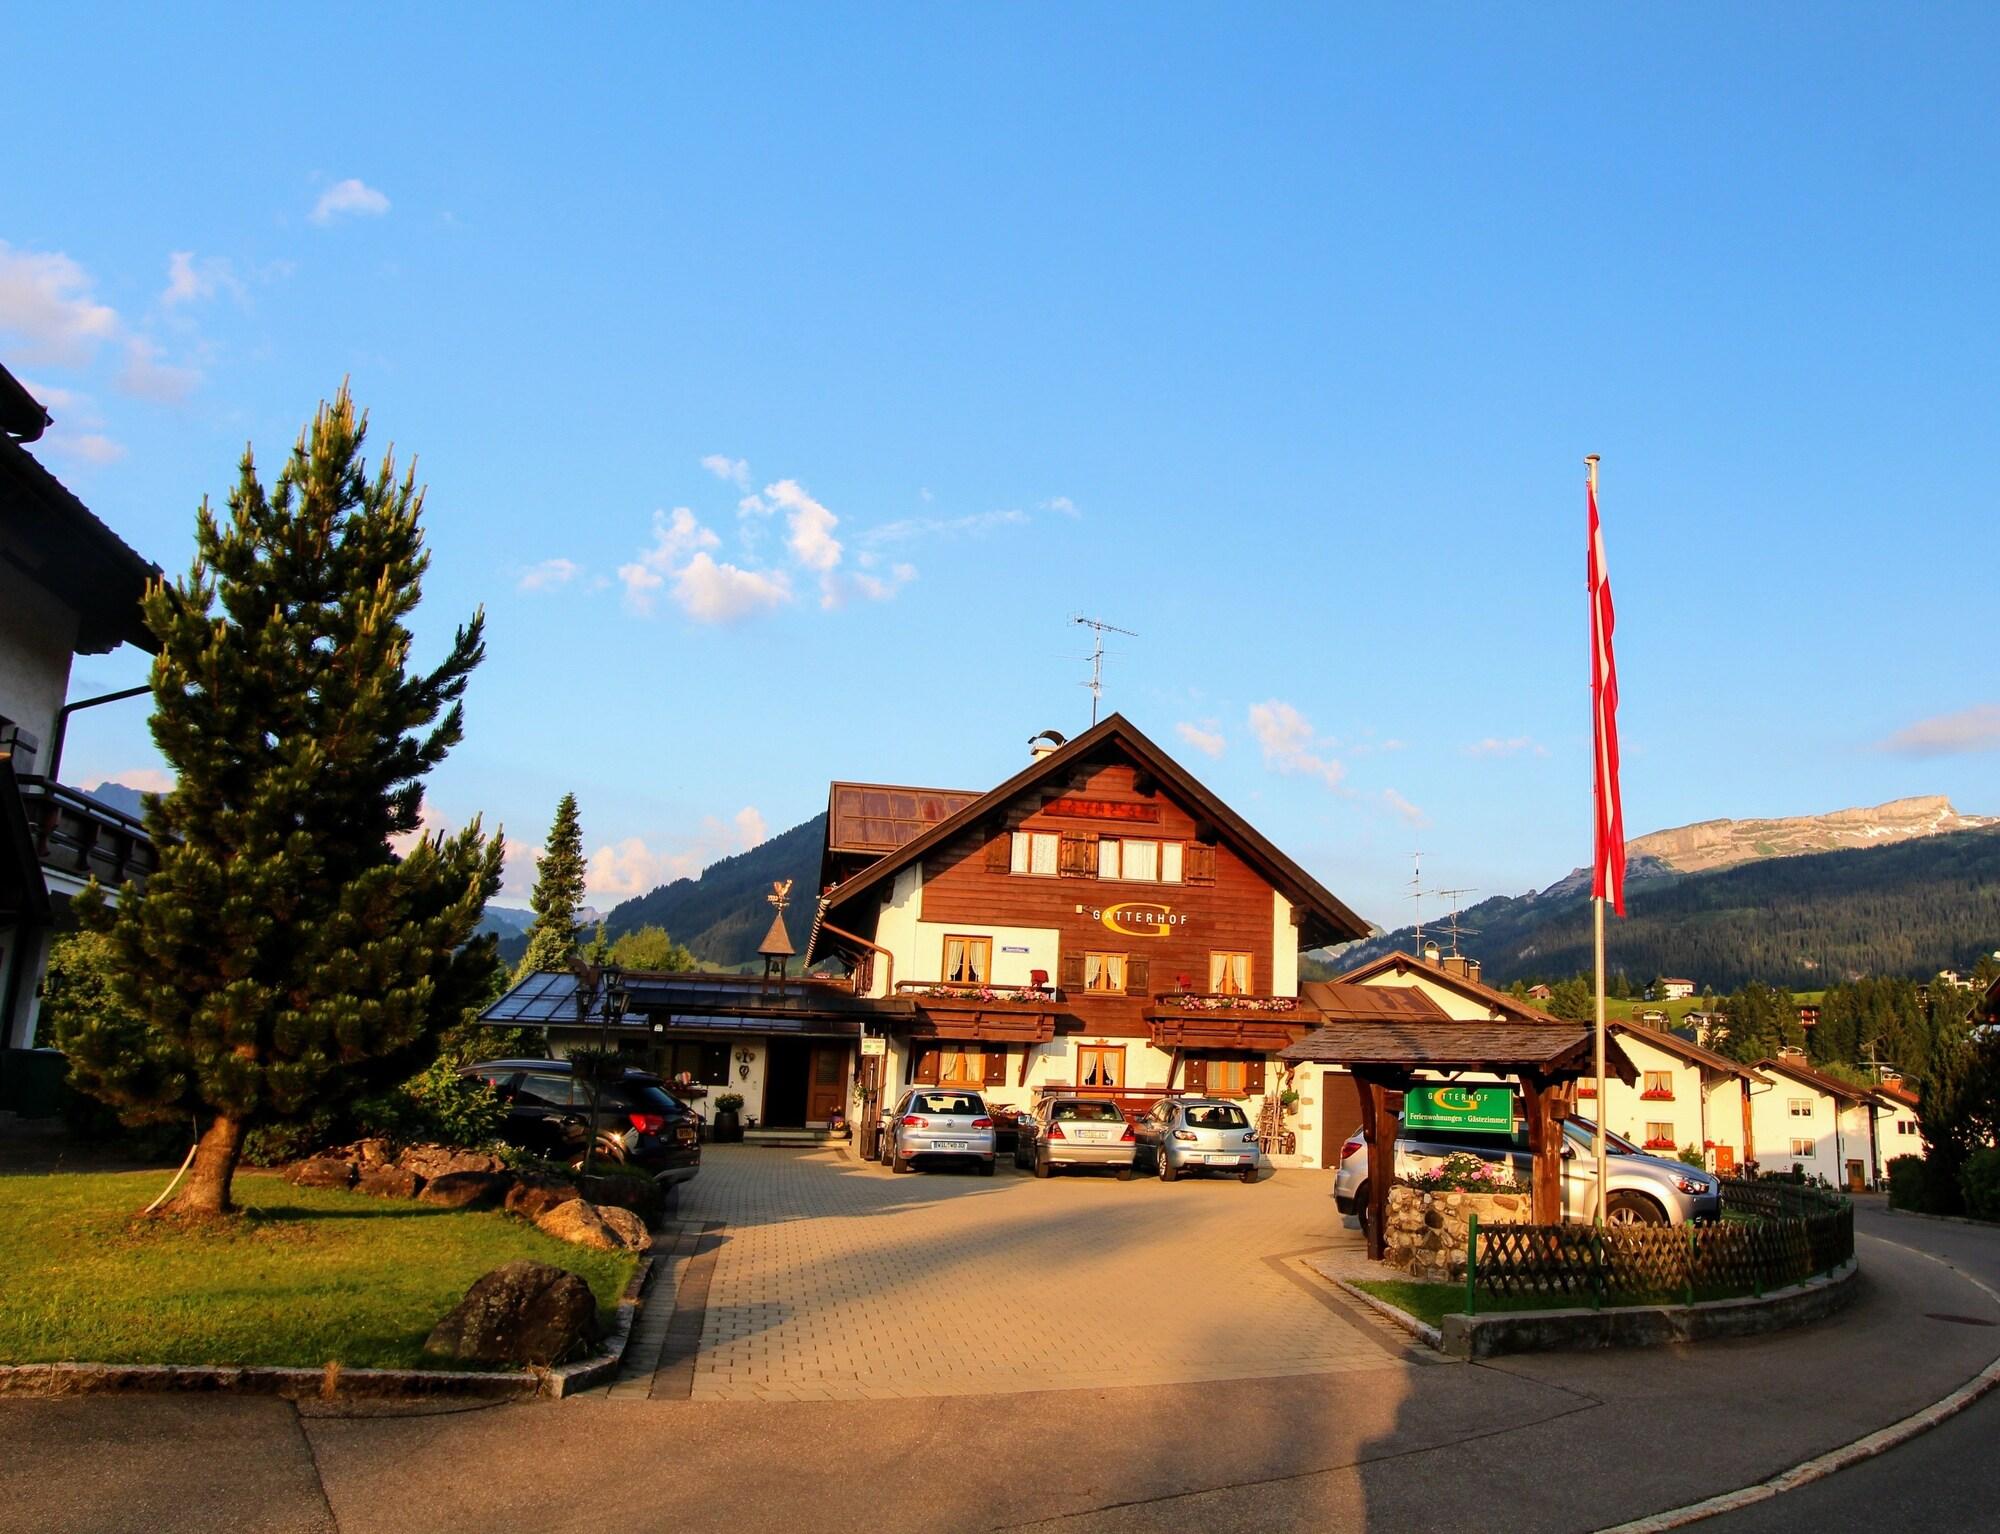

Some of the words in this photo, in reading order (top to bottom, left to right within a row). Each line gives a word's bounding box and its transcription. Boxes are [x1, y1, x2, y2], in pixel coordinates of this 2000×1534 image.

[1093, 910, 1187, 925] GATTERHOF
[1428, 1092, 1489, 1101] GTTERHOF
[1410, 1112, 1462, 1123] Ferienwohnungen
[1467, 1115, 1507, 1124] Gästezimmer
